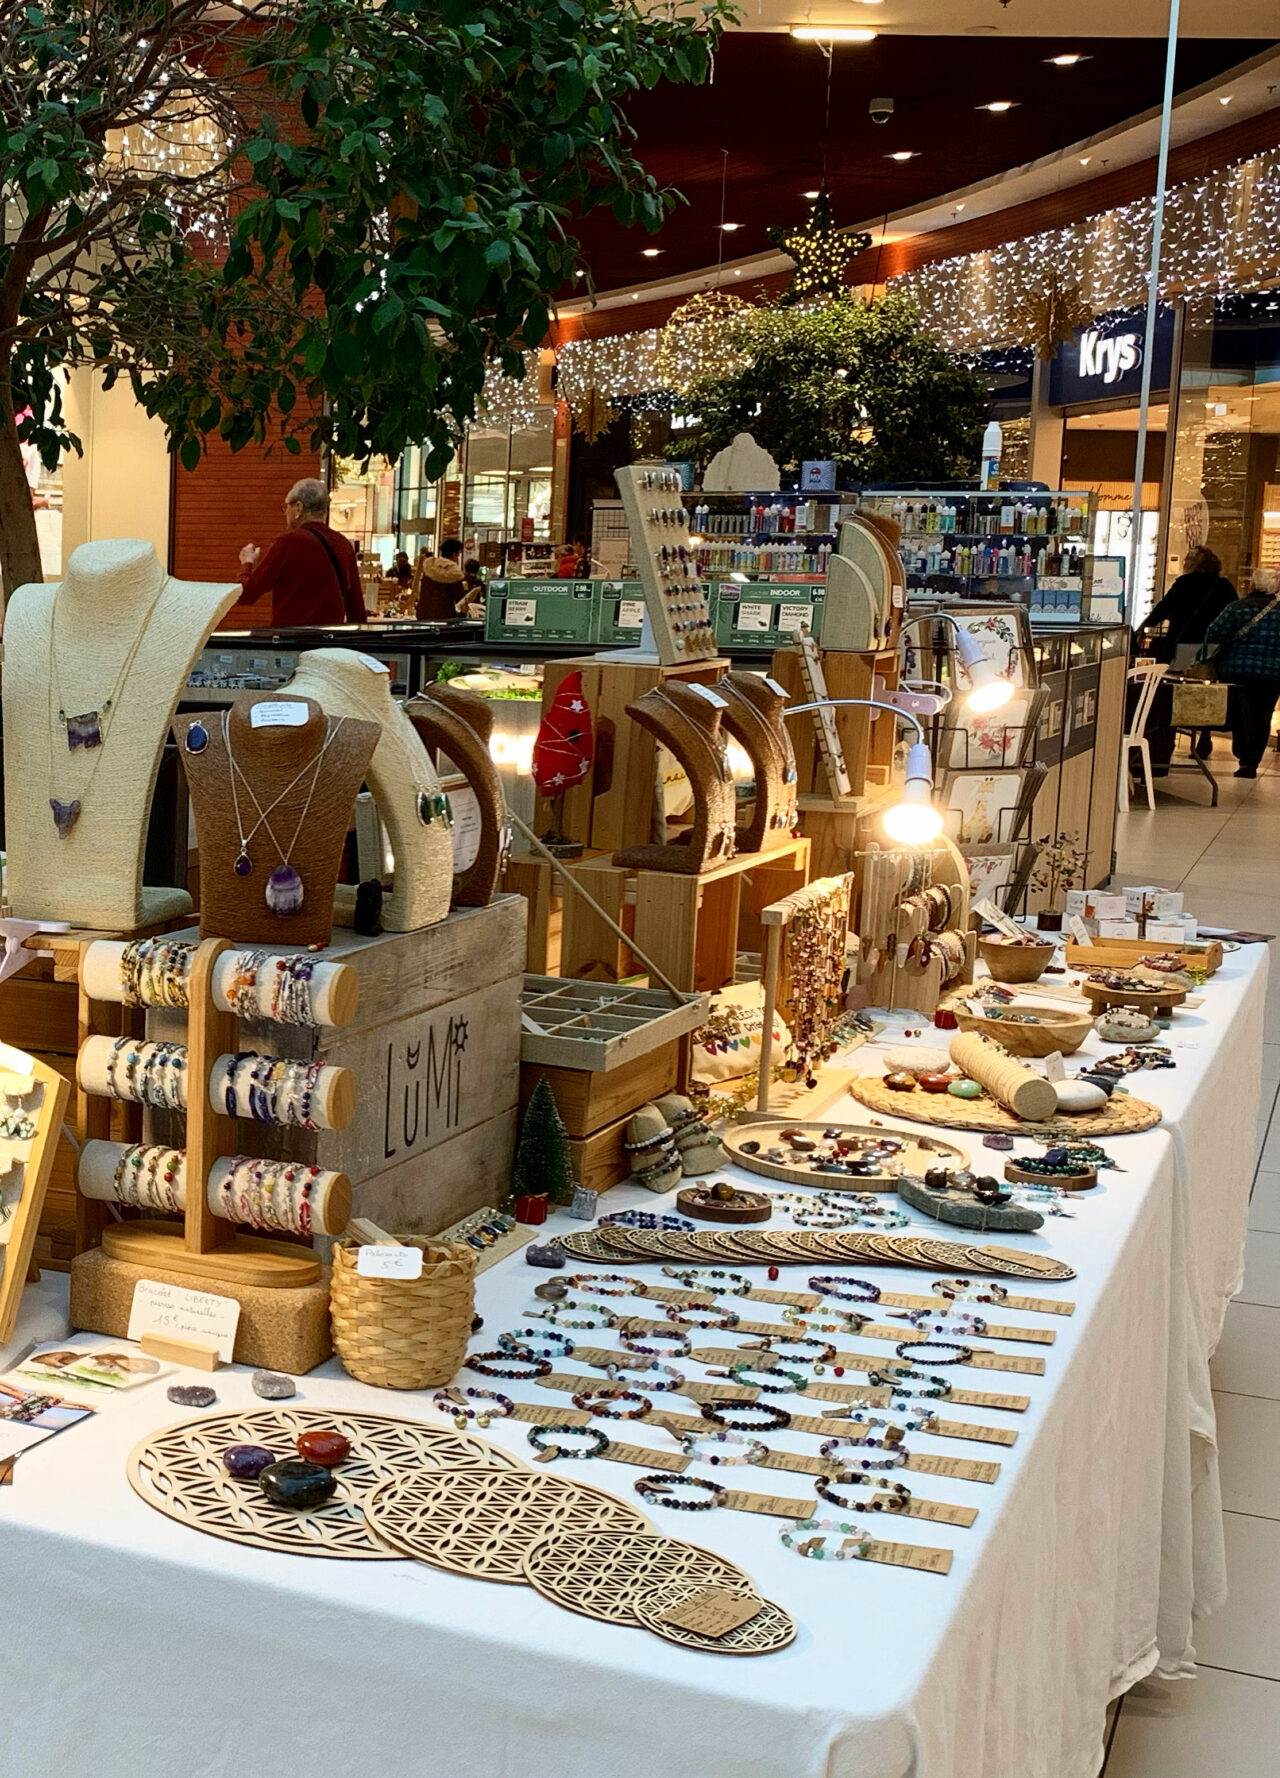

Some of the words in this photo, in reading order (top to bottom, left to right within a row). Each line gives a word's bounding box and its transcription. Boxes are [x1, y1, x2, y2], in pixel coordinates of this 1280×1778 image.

[1079, 331, 1140, 384] Krys
[532, 585, 569, 593] OUTDOOR
[770, 589, 801, 597] INDOOR
